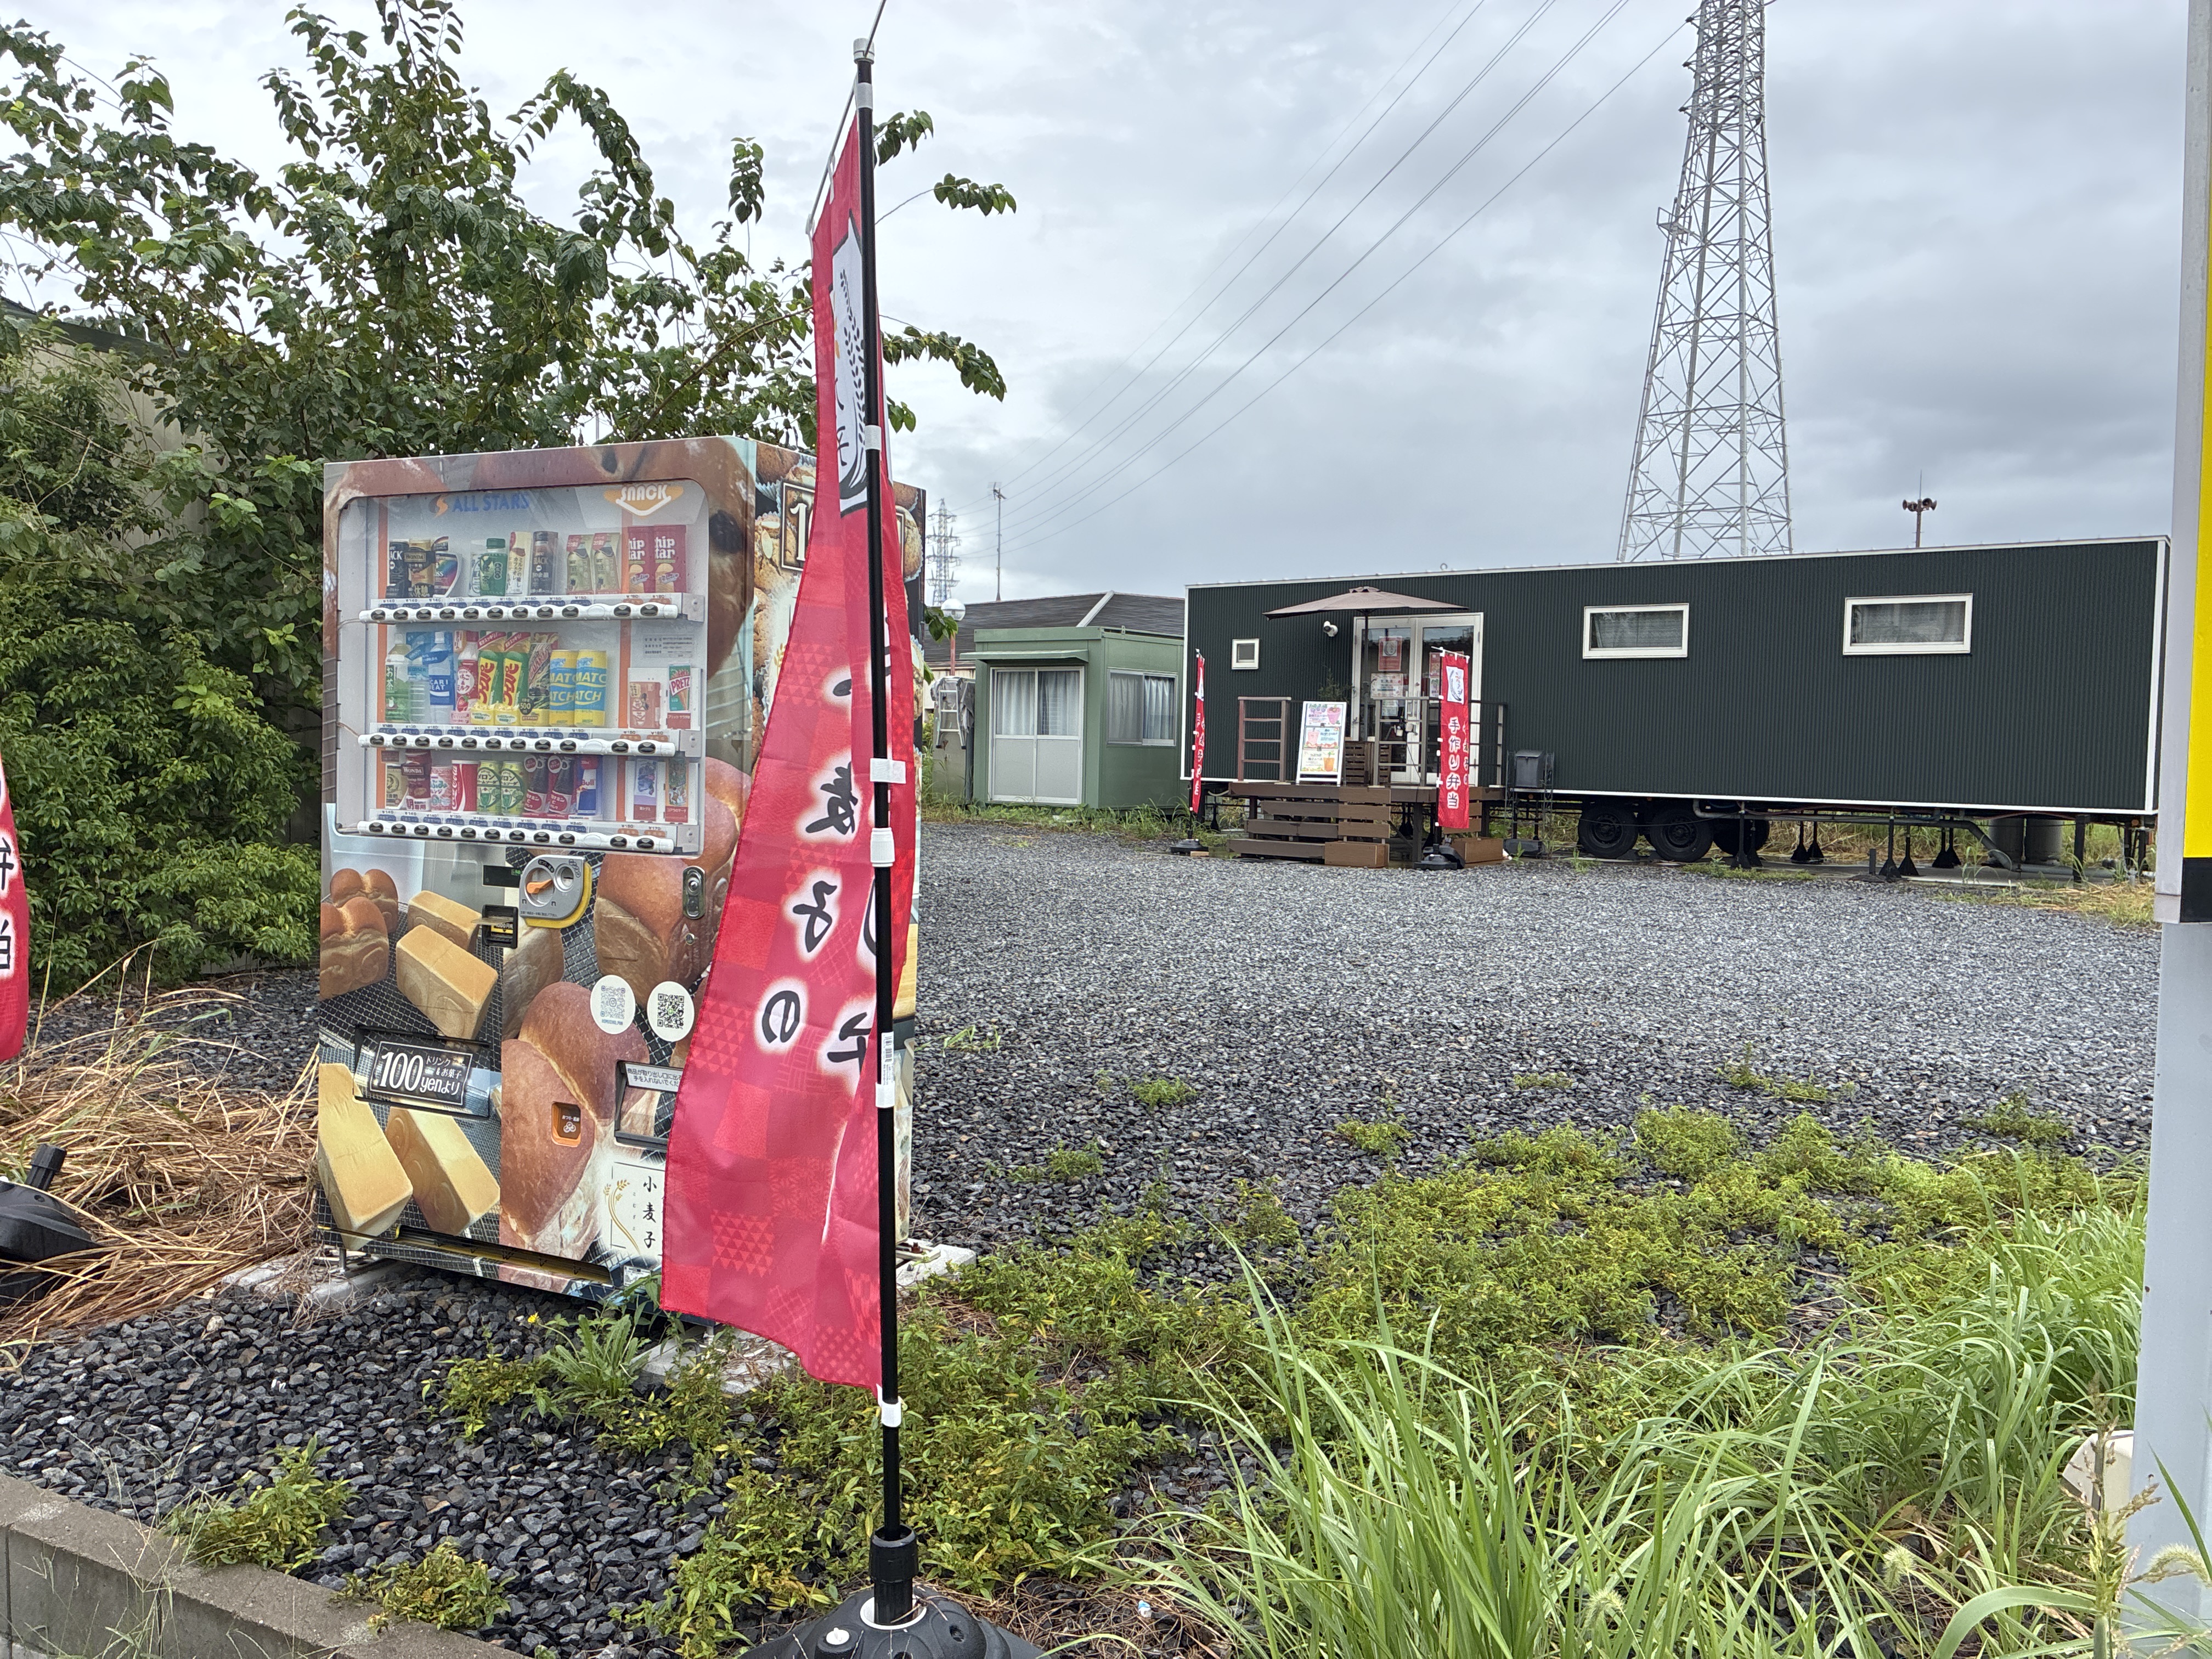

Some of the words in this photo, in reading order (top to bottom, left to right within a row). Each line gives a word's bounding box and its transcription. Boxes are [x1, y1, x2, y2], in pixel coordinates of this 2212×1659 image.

[452, 495, 478, 512] ALL
[483, 492, 530, 511] STARS
[620, 484, 668, 501] SNACK
[386, 665, 393, 691] お茶
[671, 677, 690, 693] PRETZ
[1447, 719, 1461, 808] 手作り弁当
[379, 1052, 424, 1091] 100
[426, 1056, 452, 1067] ドリンク
[420, 1076, 460, 1096] yenより
[643, 1176, 657, 1249] 小麦子
